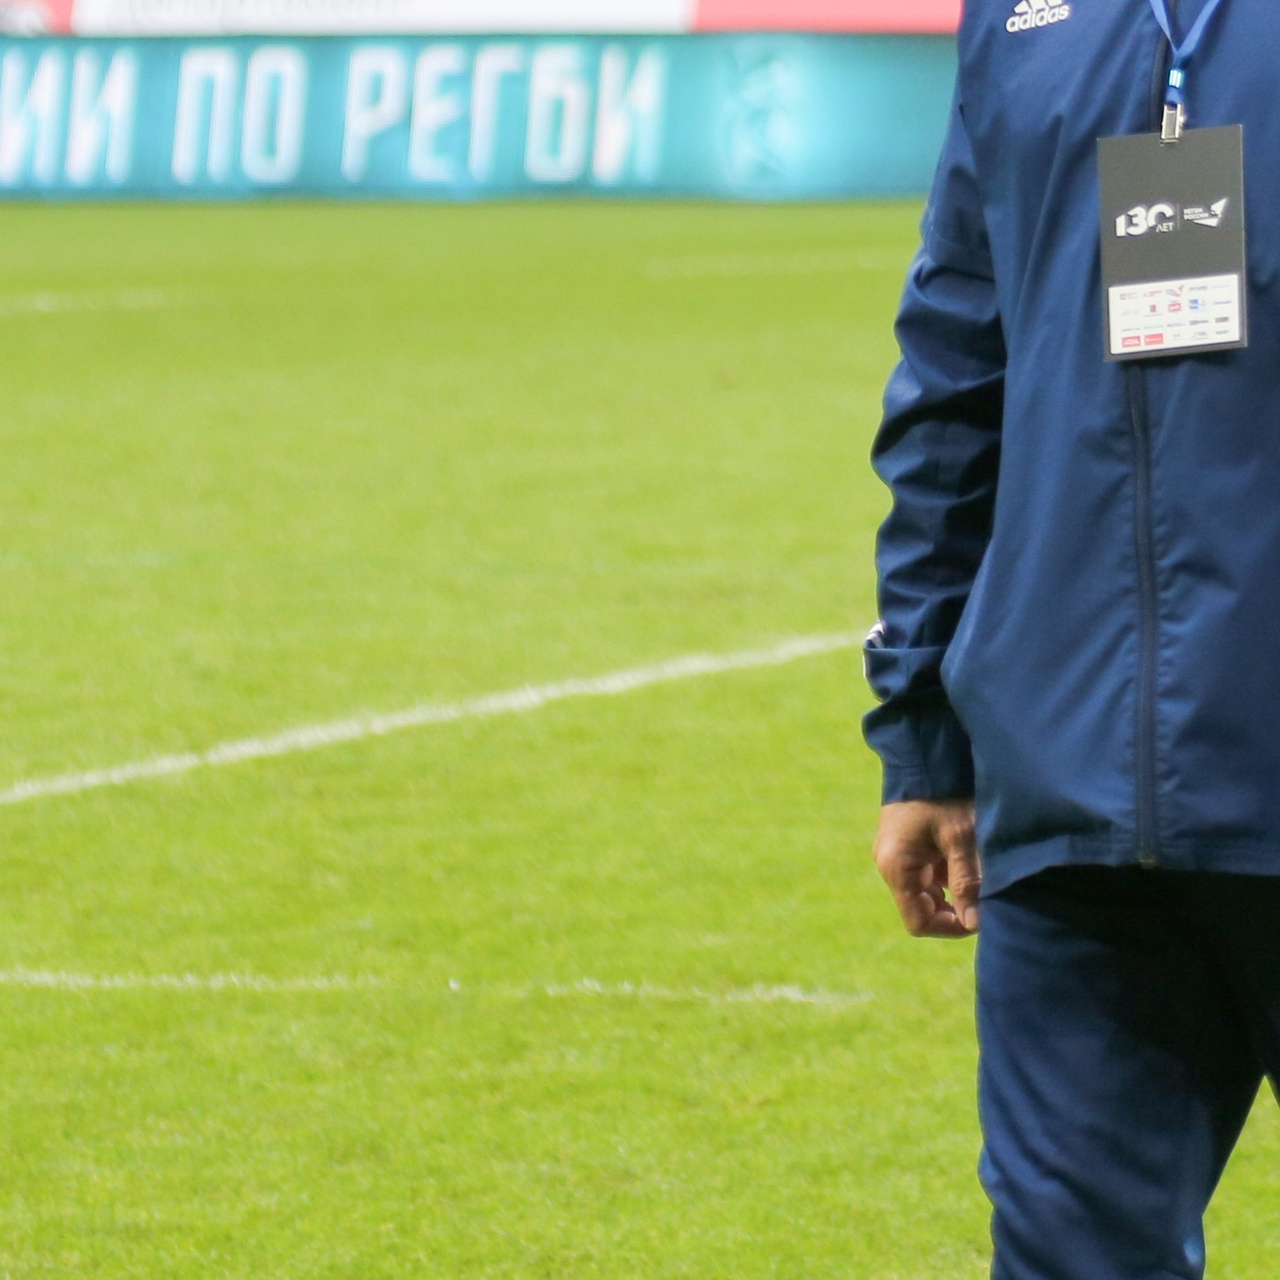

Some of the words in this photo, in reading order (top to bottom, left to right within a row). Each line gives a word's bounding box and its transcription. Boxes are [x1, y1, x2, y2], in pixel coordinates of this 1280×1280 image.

[1005, 4, 1070, 33] adidas
[172, 46, 305, 184] ПО
[341, 45, 665, 183] РЕГБИ
[1156, 222, 1174, 233] ЛЕТ
